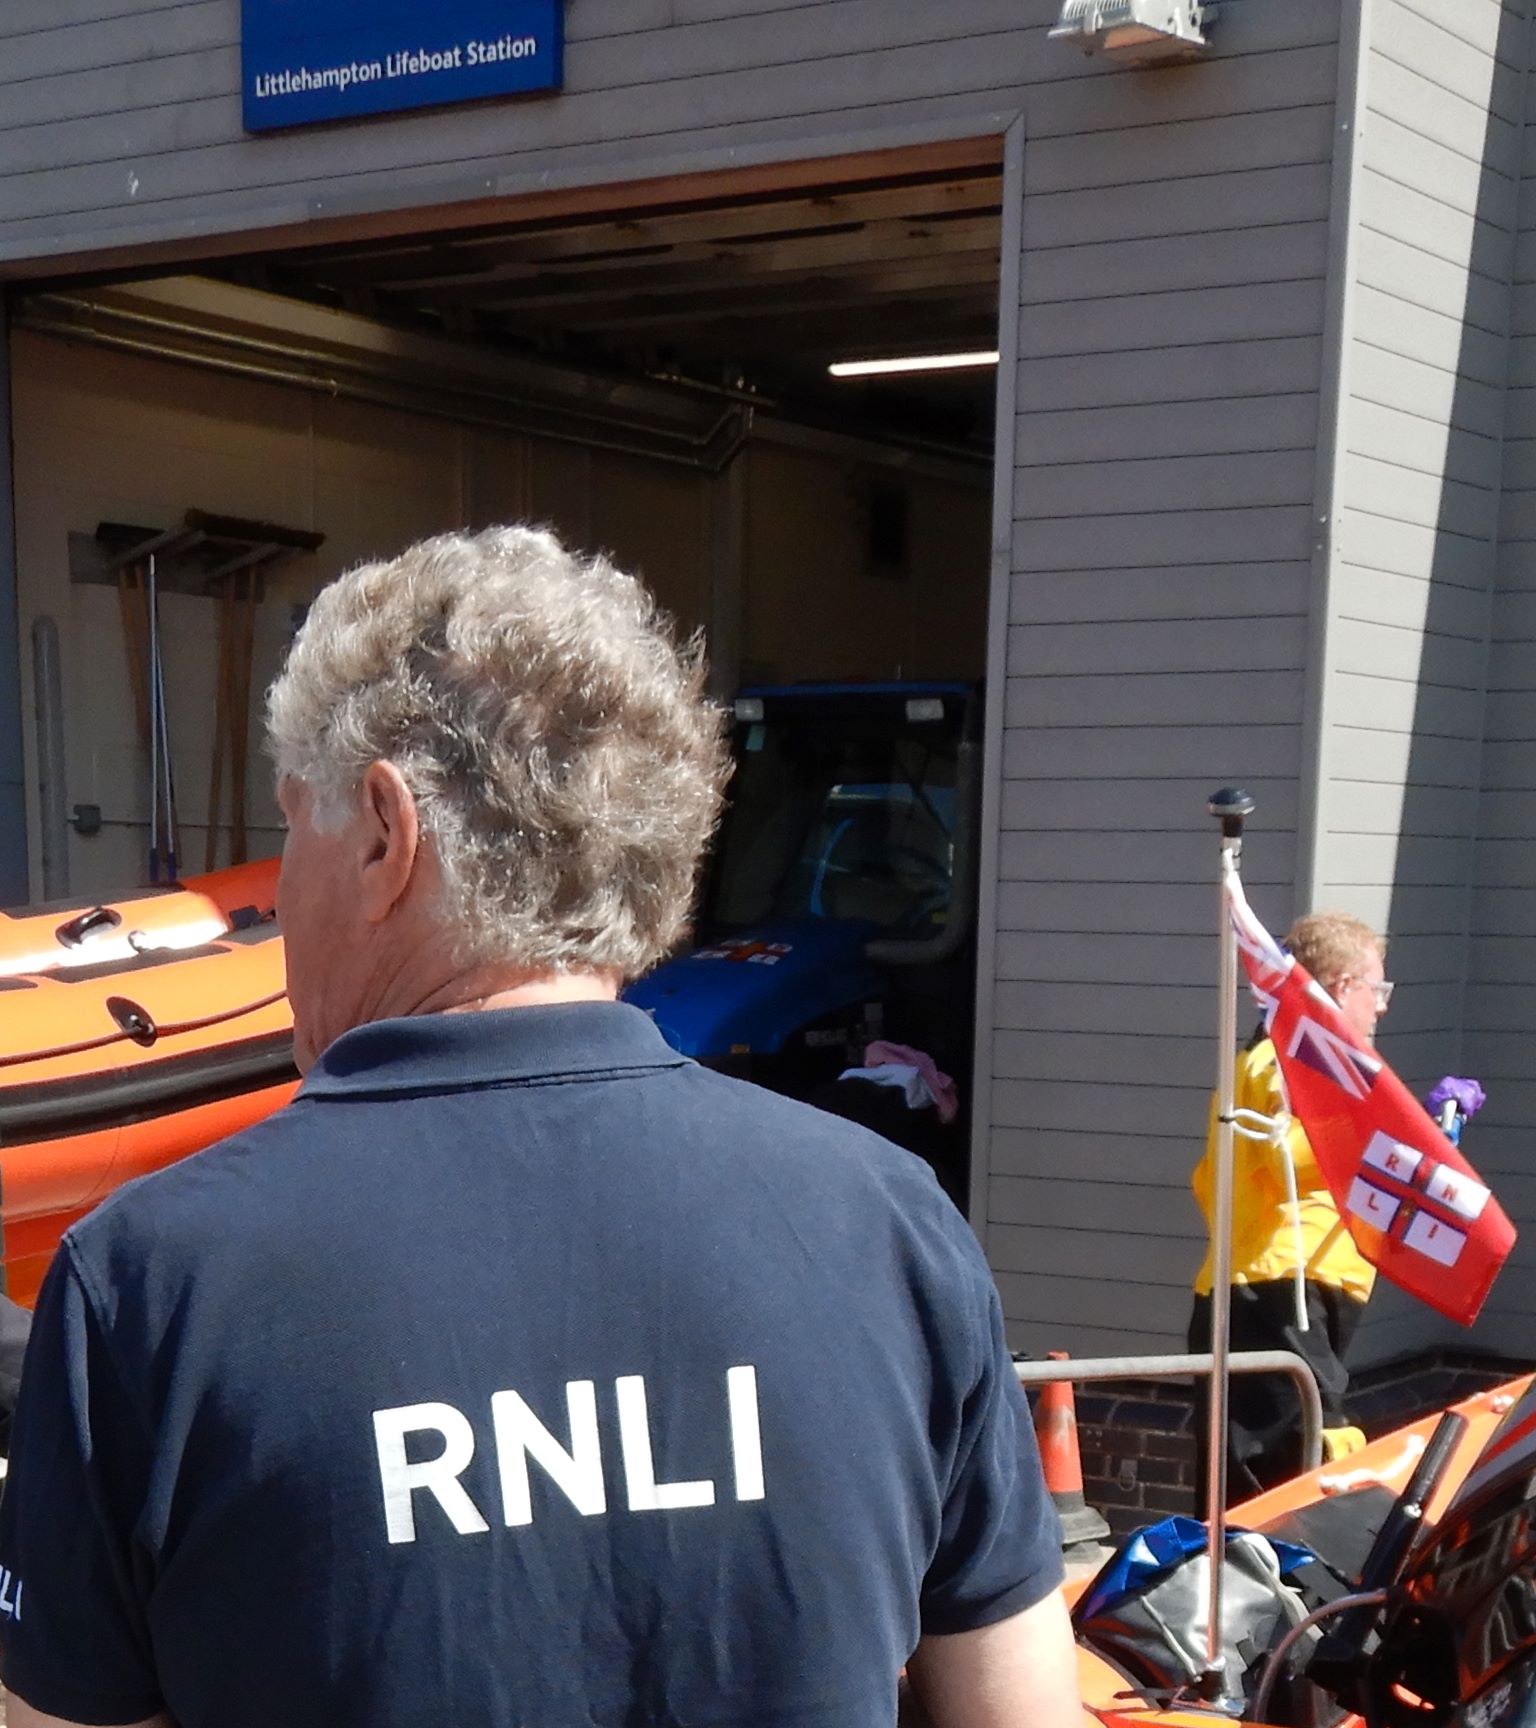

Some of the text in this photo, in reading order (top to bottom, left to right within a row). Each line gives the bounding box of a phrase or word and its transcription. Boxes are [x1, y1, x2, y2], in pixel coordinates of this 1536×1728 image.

[254, 34, 537, 98] Littlehampton Lifeboat Station
[371, 1364, 766, 1545] RNLI
